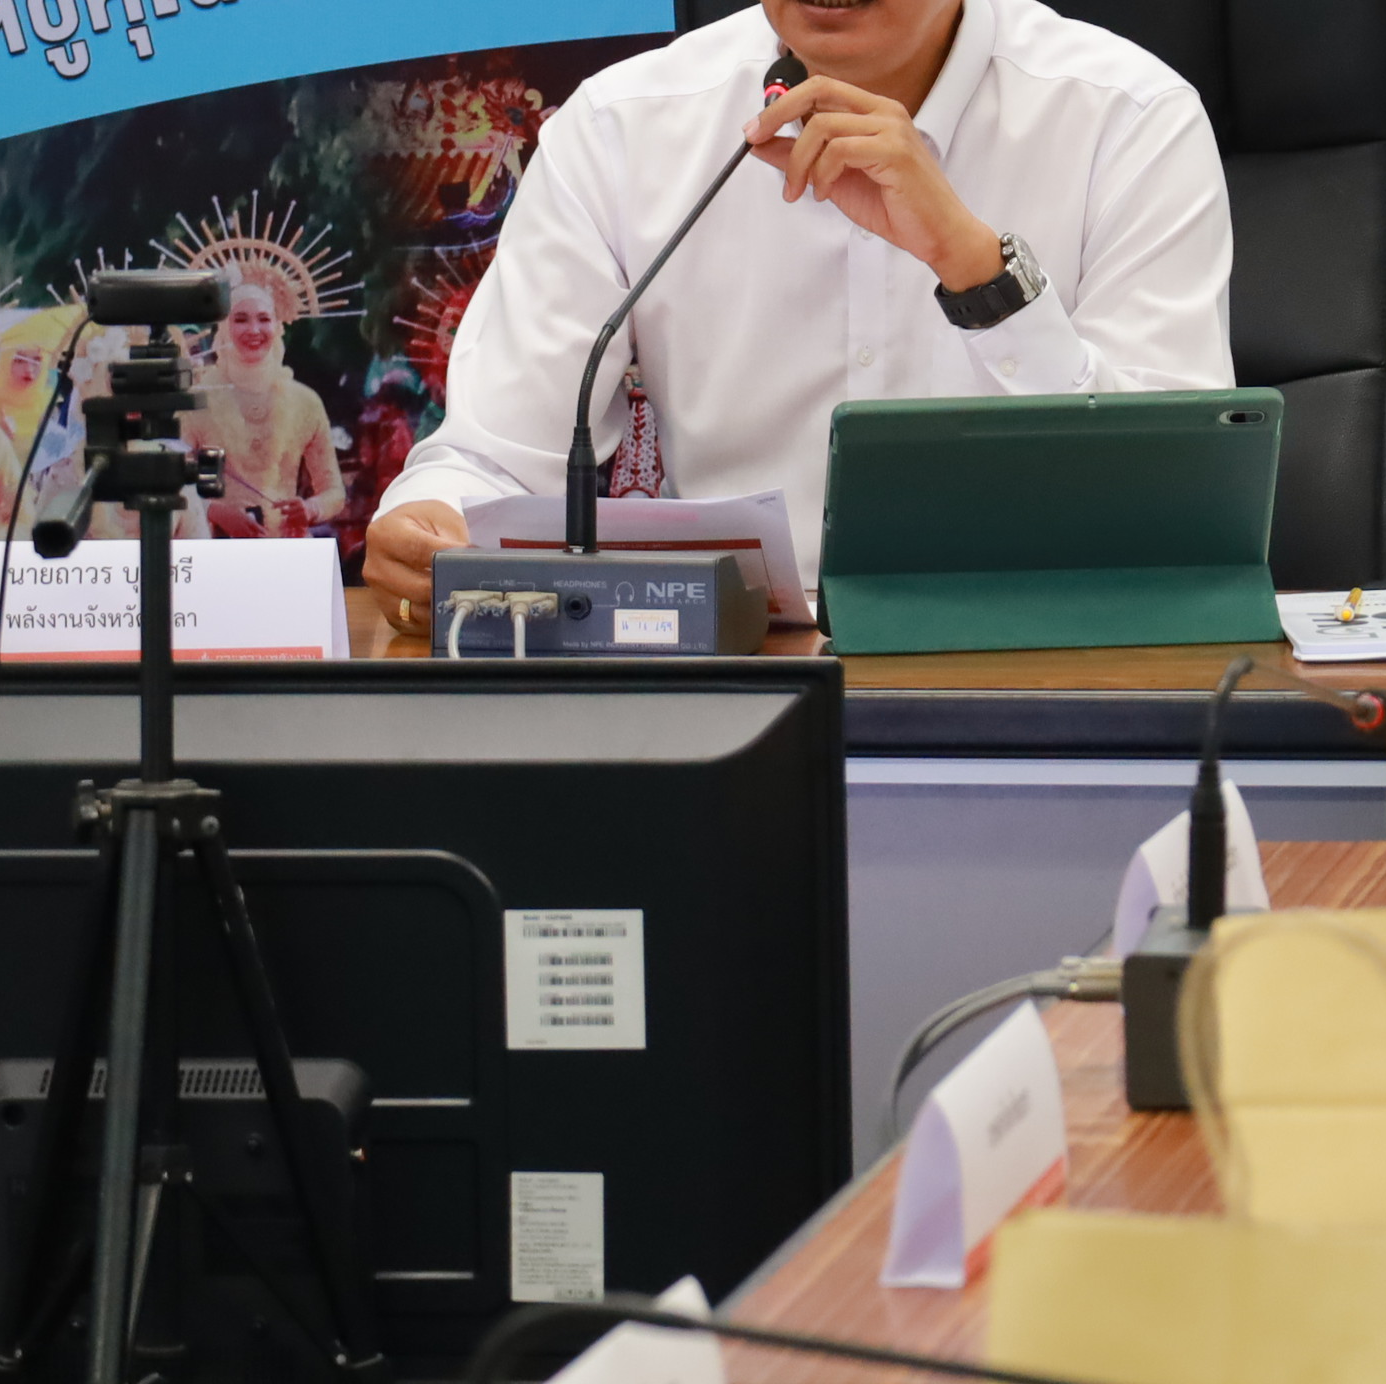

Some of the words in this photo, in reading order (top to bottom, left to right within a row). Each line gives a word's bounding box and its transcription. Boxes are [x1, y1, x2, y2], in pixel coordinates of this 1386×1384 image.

[7, 564, 112, 585] นายถาวร
[122, 556, 193, 593] บุศรี
[553, 580, 607, 589] HEADPHONES
[646, 582, 706, 599] NPE
